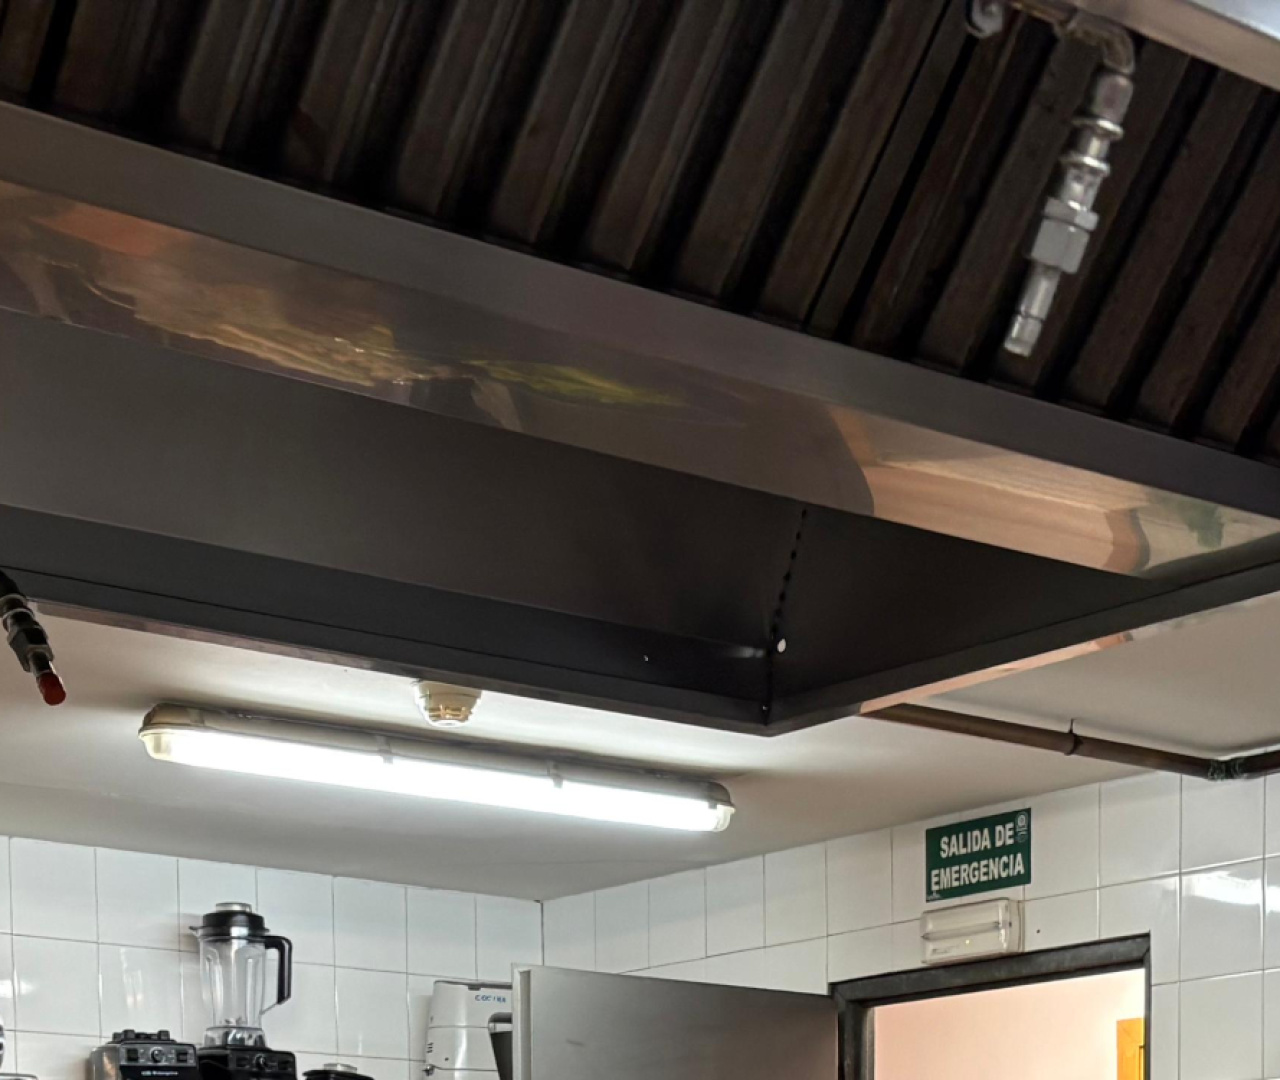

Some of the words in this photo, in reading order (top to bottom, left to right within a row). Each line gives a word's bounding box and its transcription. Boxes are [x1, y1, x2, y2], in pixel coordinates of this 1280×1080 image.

[940, 828, 992, 859] SALIDA
[995, 822, 1015, 848] DE
[931, 853, 1025, 891] EMERGENCIA
